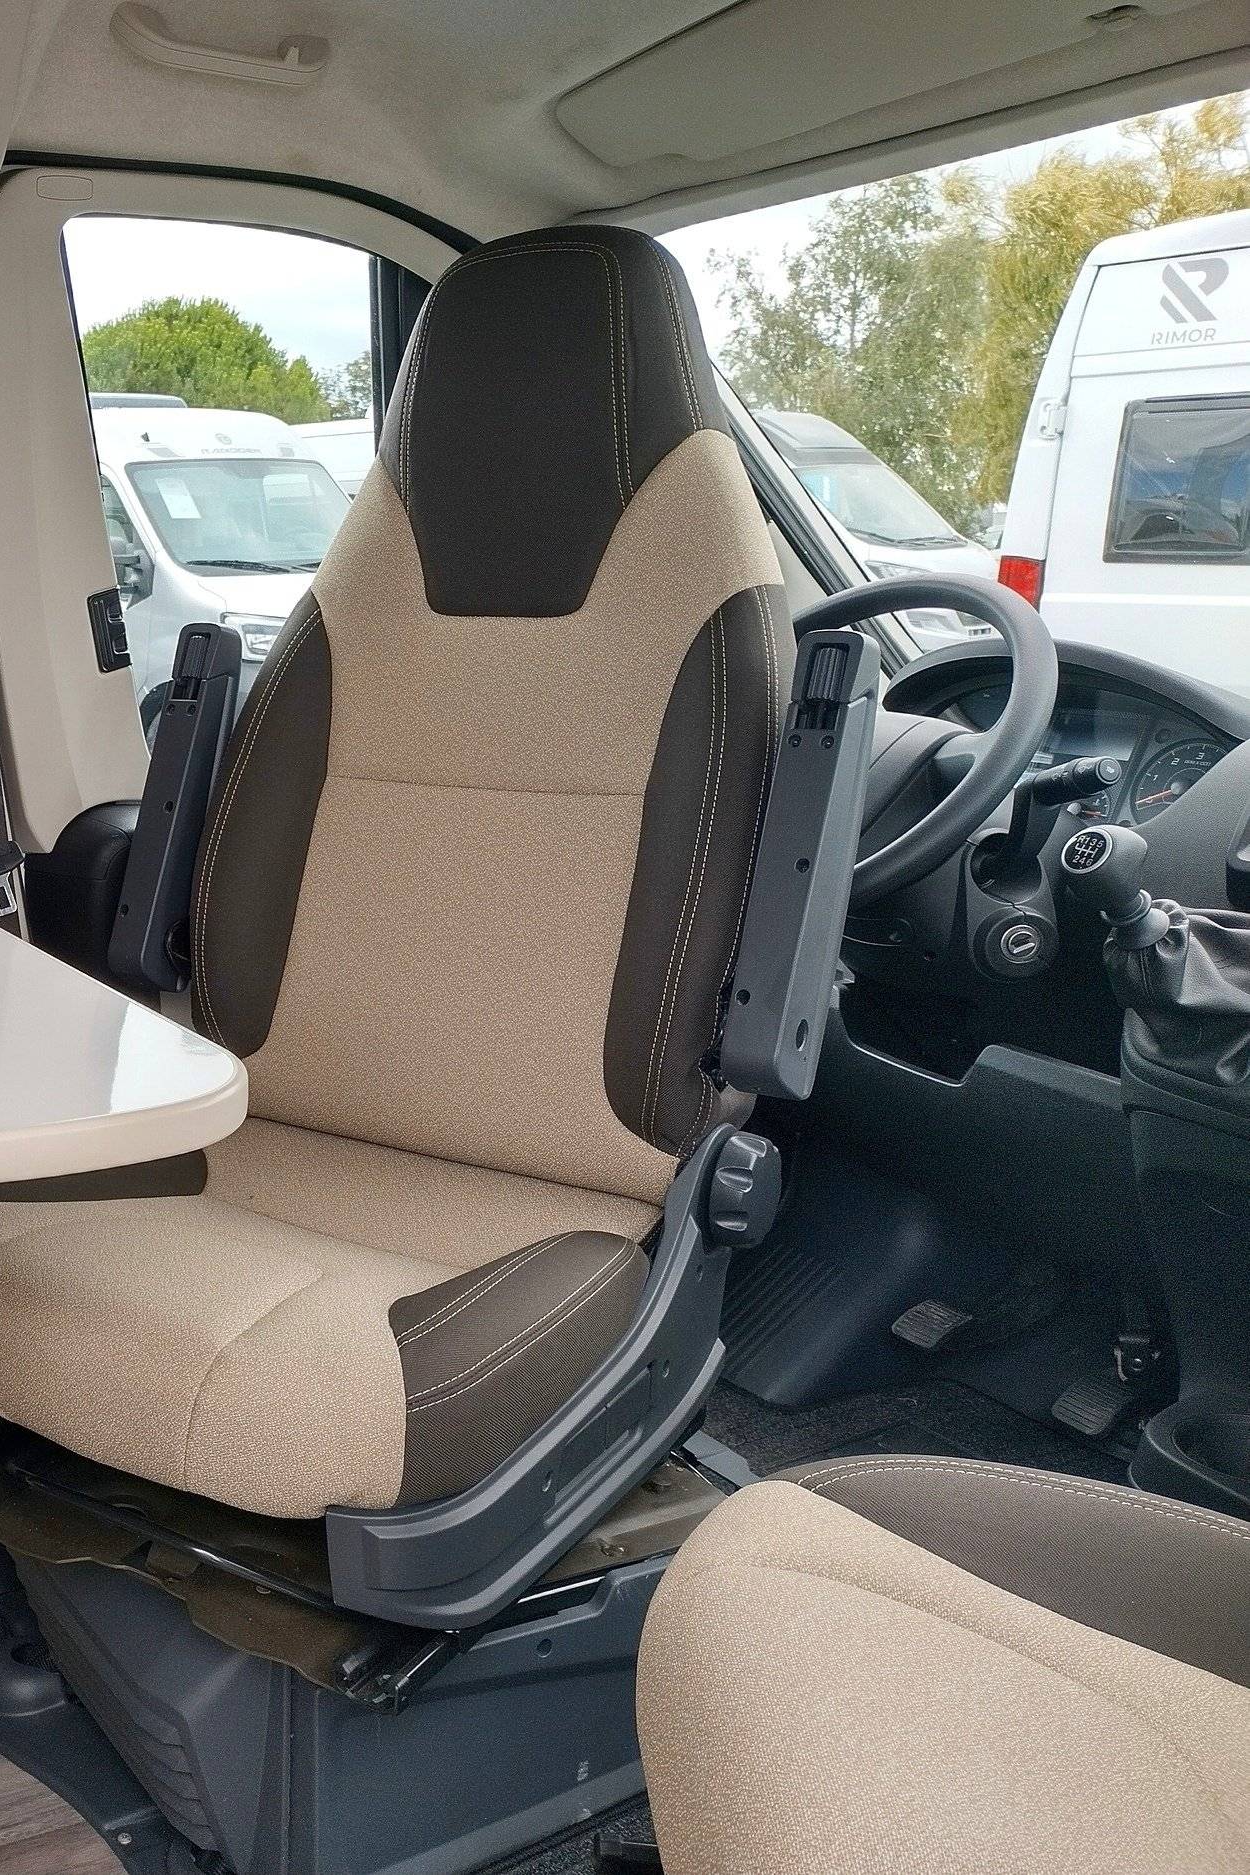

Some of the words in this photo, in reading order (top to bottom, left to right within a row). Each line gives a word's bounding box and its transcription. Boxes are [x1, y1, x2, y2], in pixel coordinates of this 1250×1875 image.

[1151, 328, 1216, 345] RIMOR
[1196, 752, 1205, 760] 3
[1171, 757, 1180, 766] 2
